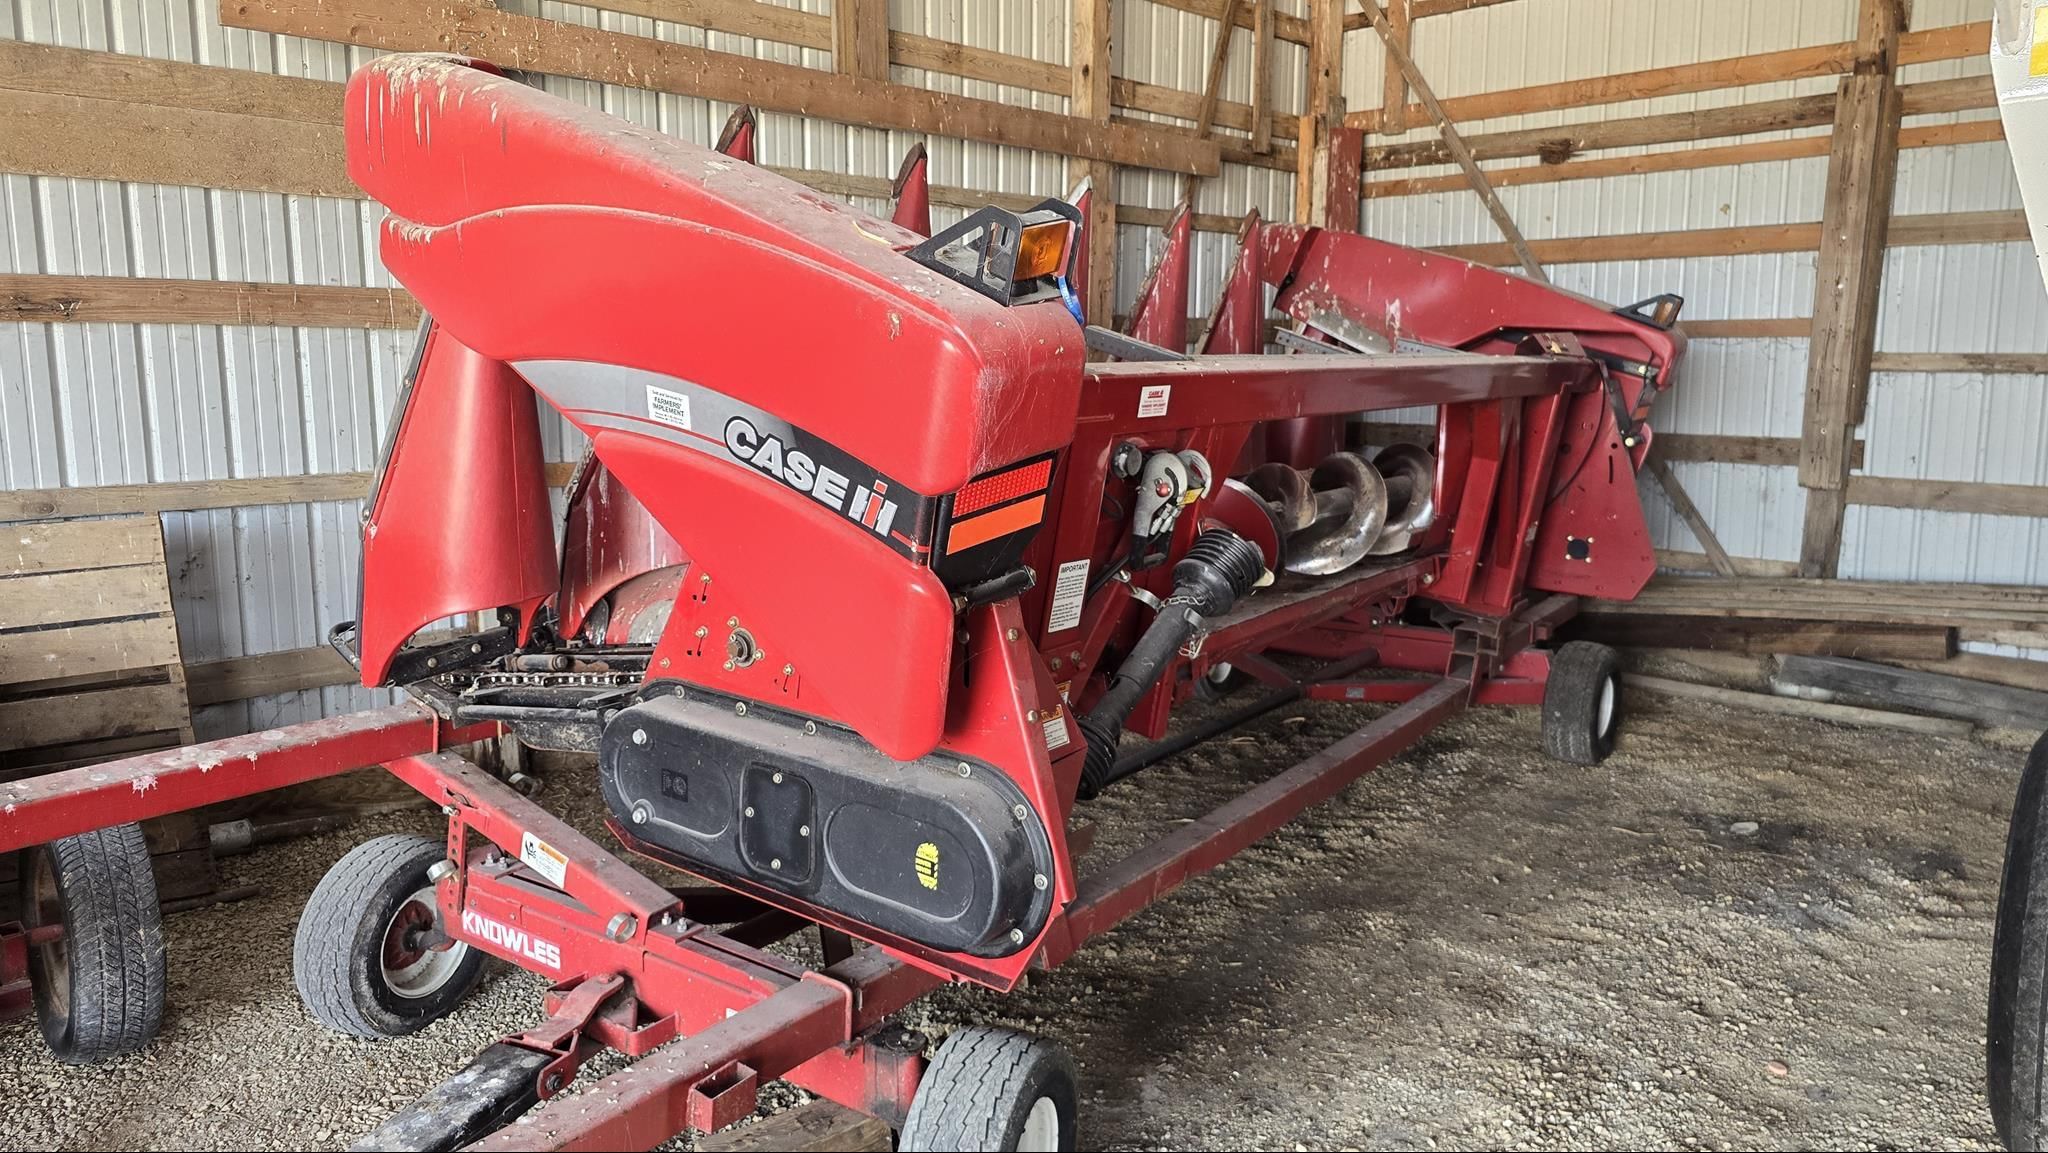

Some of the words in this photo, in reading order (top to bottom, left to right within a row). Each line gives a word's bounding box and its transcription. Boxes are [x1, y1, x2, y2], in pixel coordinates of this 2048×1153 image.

[652, 402, 684, 417] IMPLEMENT
[725, 416, 849, 511] CASE
[1060, 562, 1088, 573] IMPORTANT
[462, 909, 561, 970] KNOWLES
